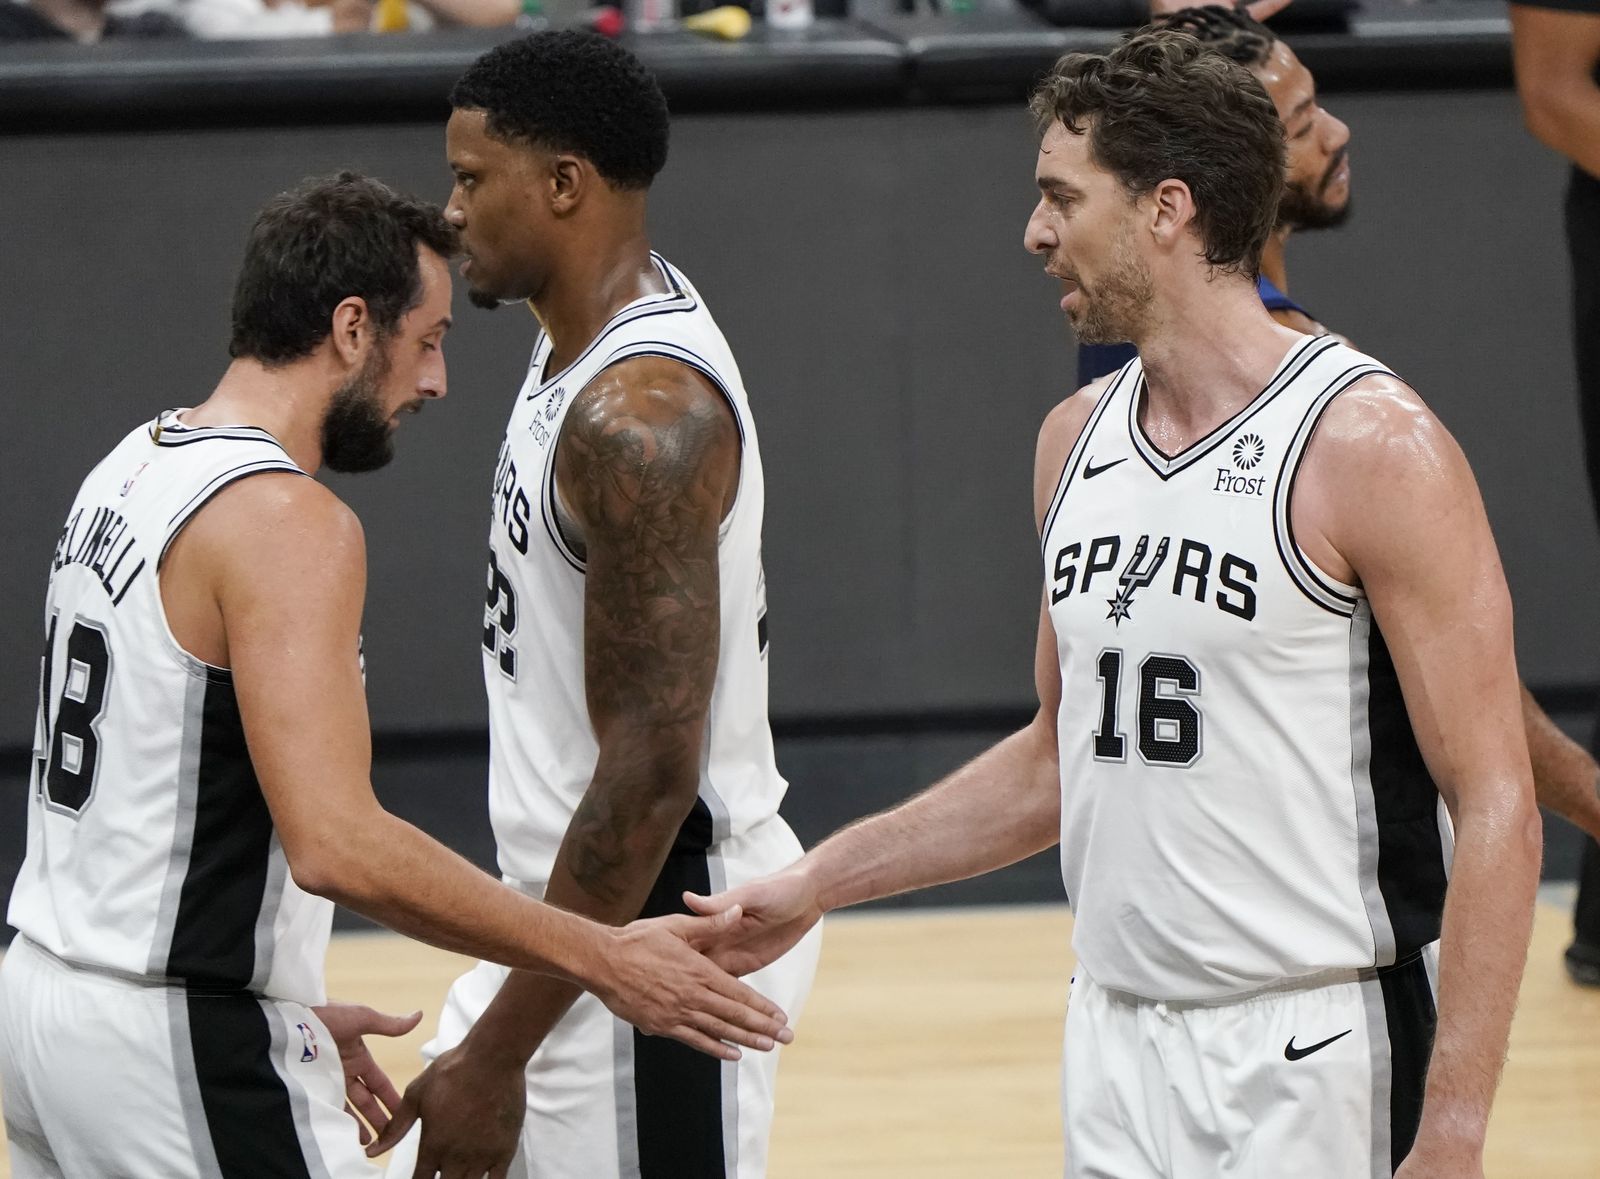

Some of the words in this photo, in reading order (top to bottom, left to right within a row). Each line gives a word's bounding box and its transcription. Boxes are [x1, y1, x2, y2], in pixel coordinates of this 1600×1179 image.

[491, 439, 530, 556] URS
[1213, 467, 1266, 497] Frost
[1051, 534, 1258, 628] SPURS
[34, 607, 114, 822] 18
[1092, 647, 1204, 769] 16
